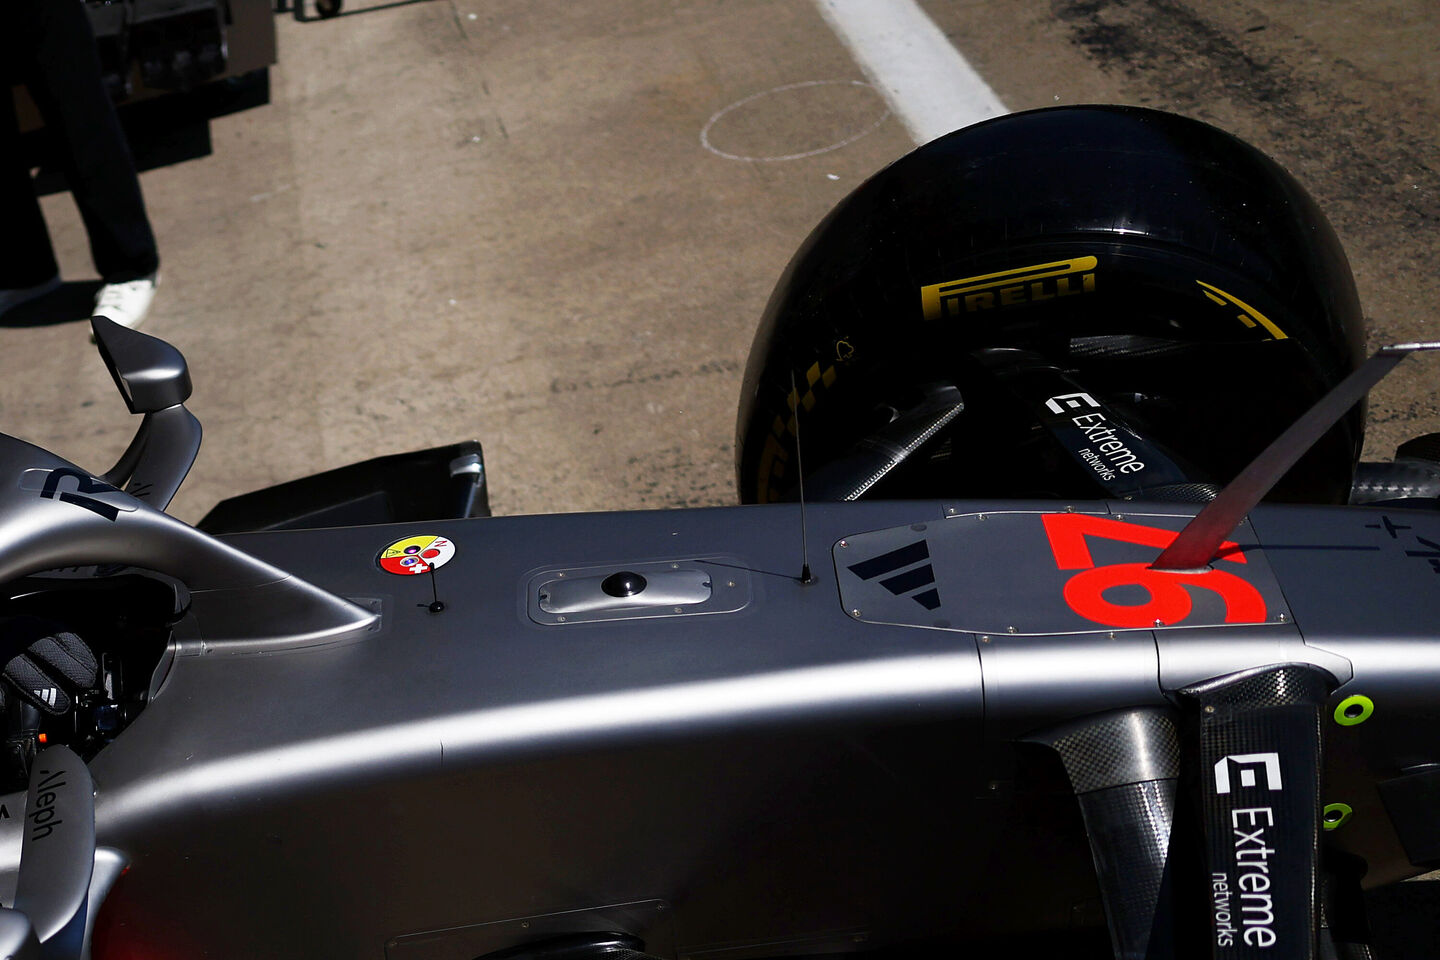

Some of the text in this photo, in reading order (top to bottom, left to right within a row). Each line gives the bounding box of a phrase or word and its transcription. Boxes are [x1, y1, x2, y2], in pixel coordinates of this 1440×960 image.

[921, 255, 1099, 321] PIRELLI
[1071, 412, 1145, 474] Extreme
[1077, 448, 1116, 481] networks
[1041, 512, 1268, 629] 97
[1211, 872, 1239, 948] networks
[1231, 806, 1278, 949] Extreme
